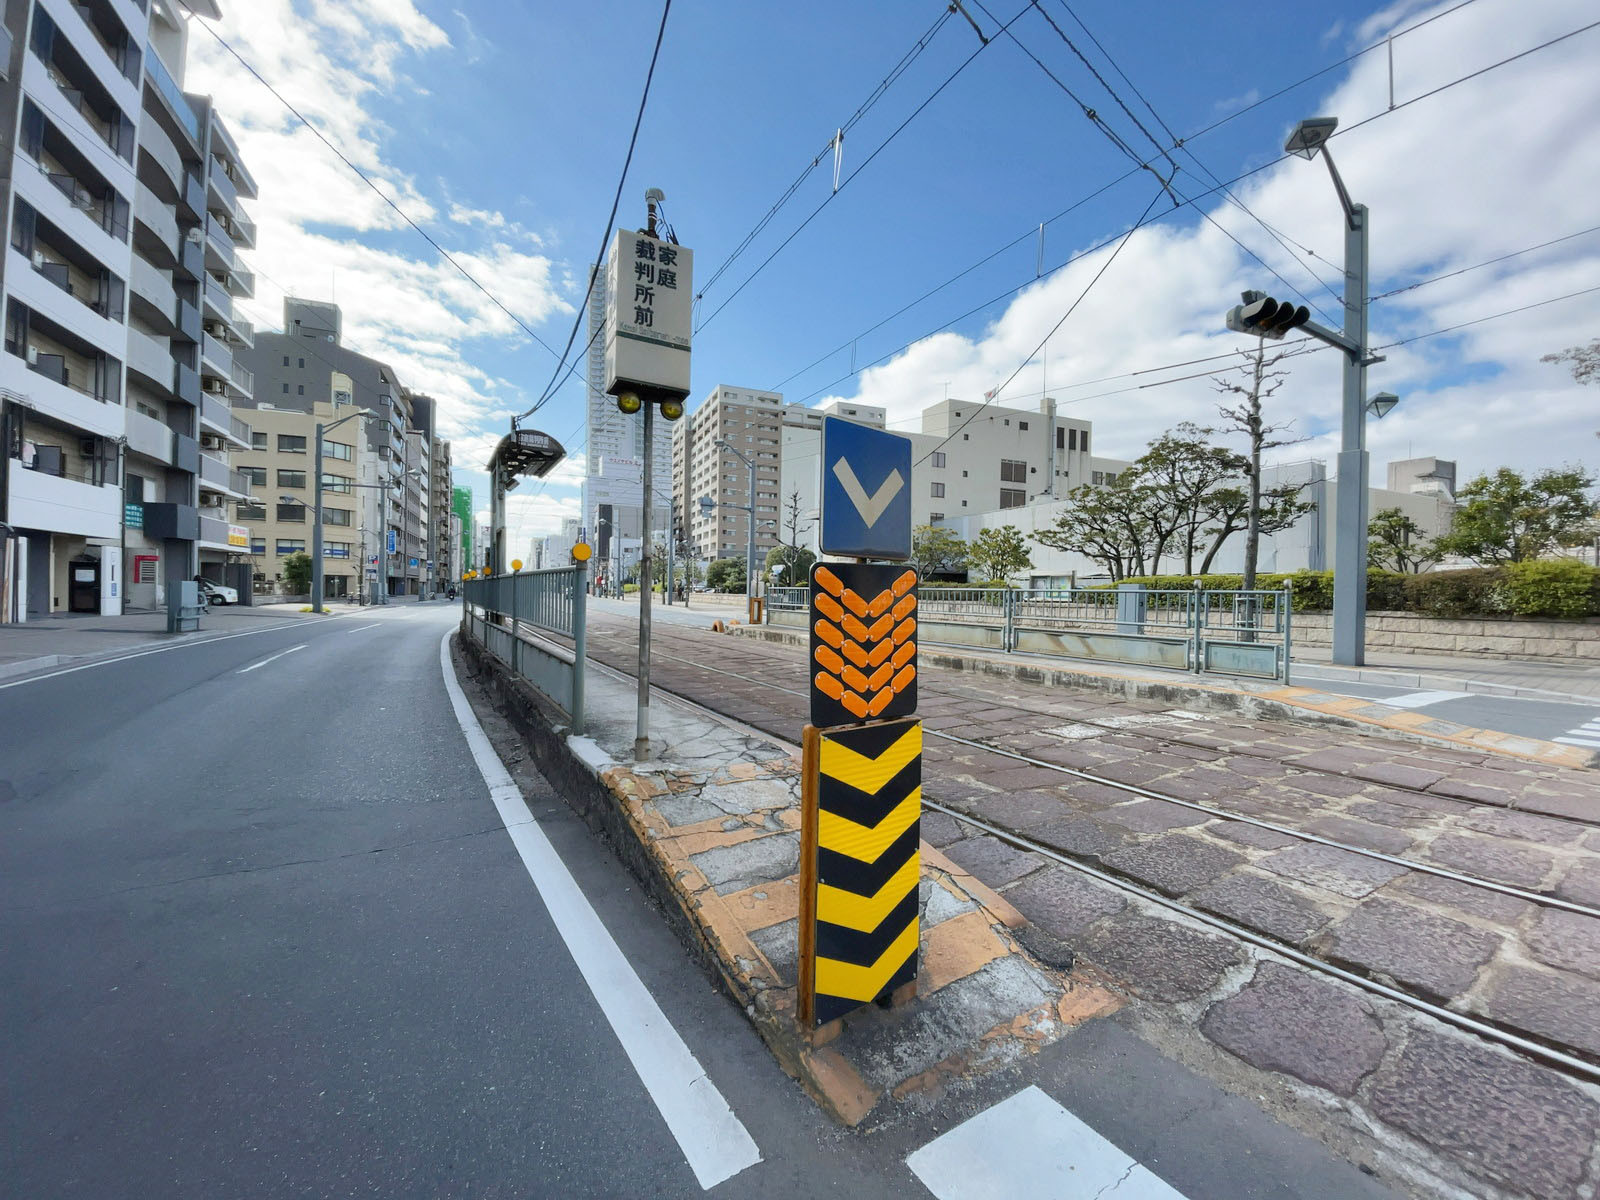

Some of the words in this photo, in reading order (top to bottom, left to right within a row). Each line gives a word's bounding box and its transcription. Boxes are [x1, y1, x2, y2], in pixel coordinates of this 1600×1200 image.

[634, 239, 656, 327] 裁判所前
[656, 246, 678, 290] 家庭
